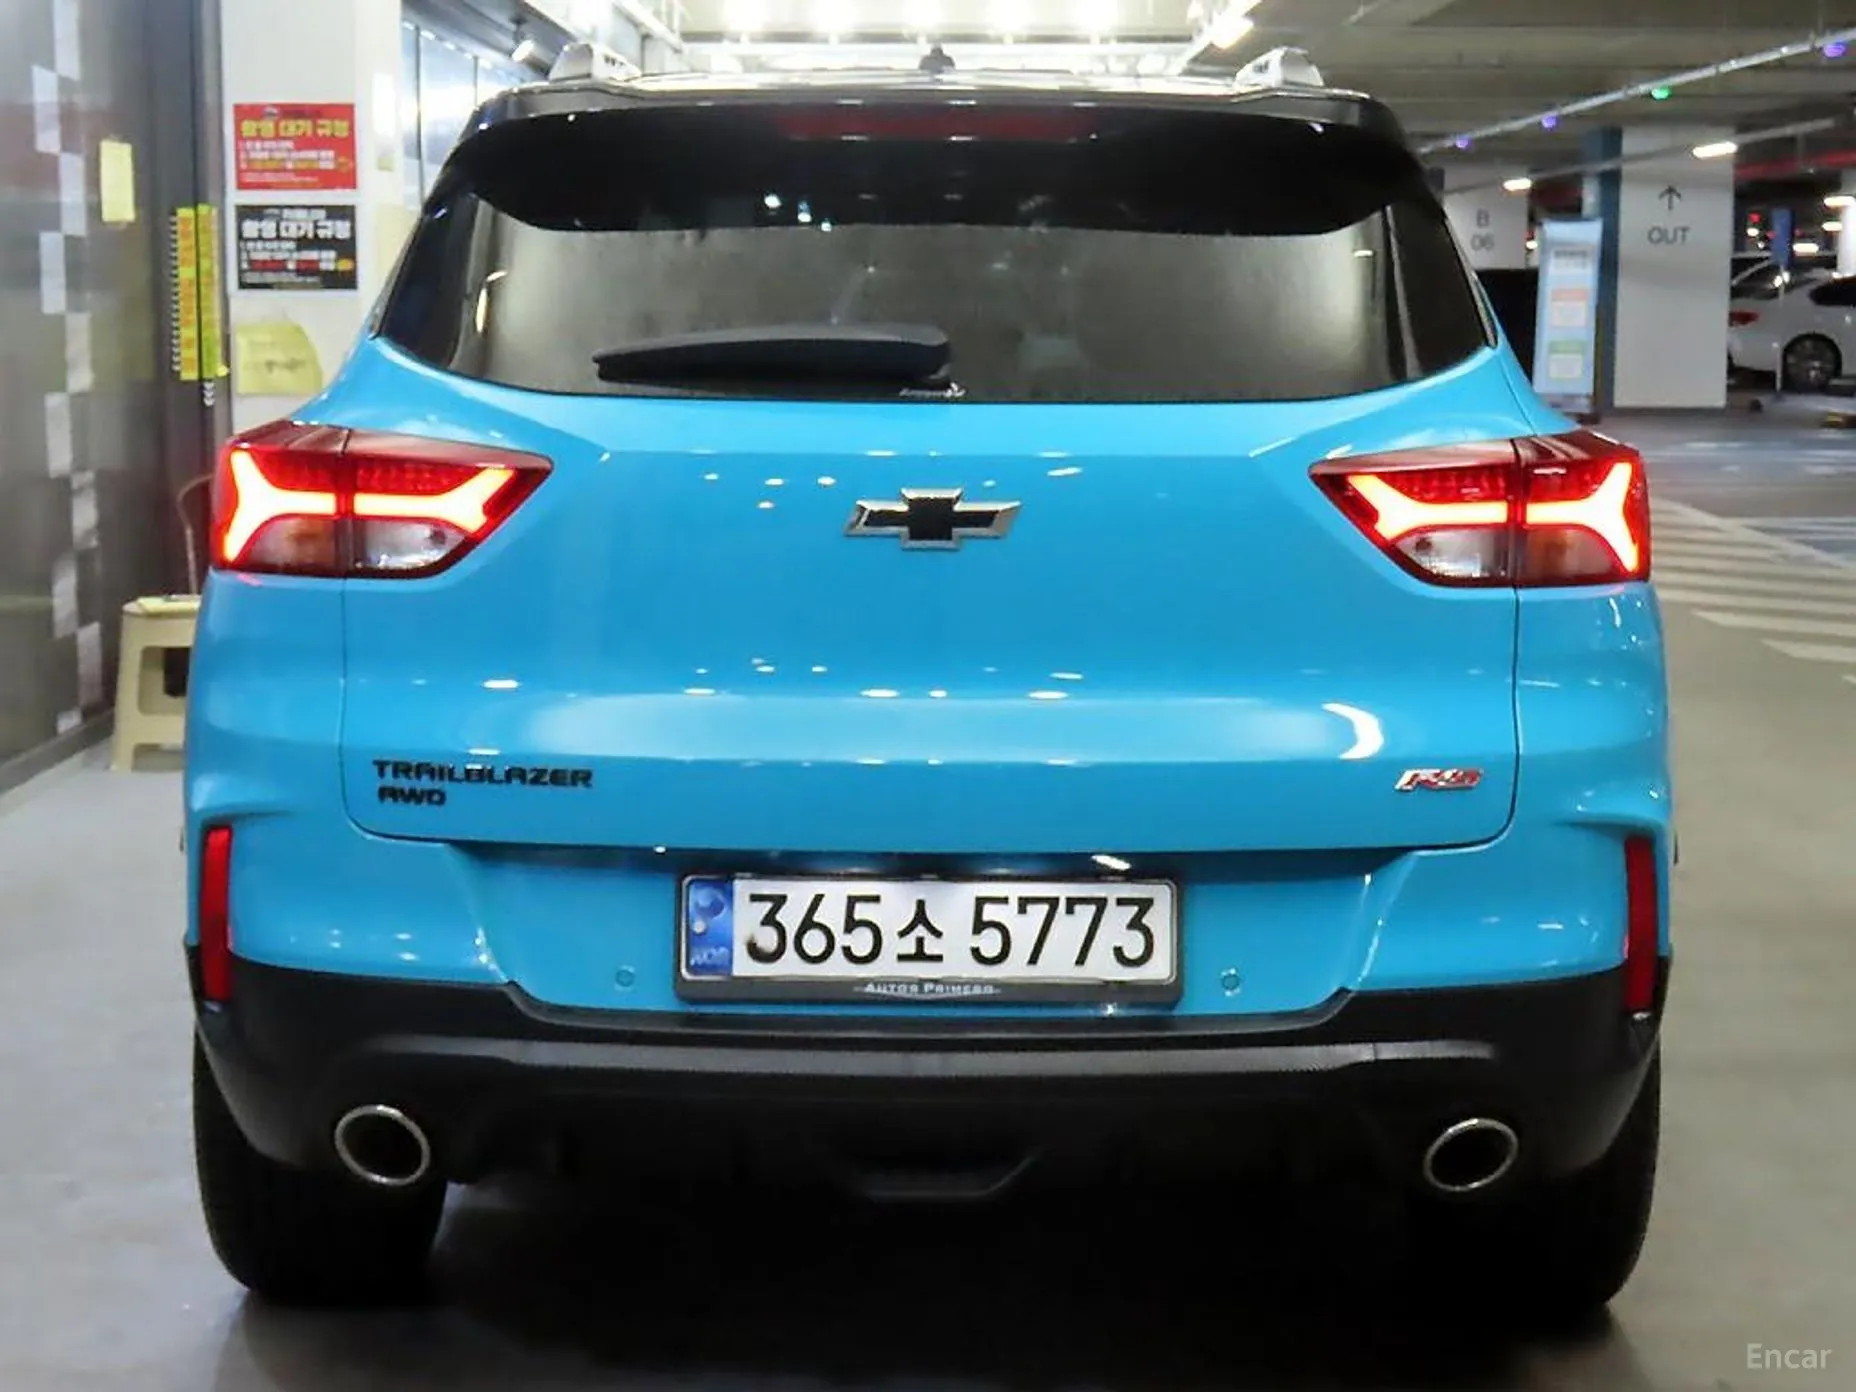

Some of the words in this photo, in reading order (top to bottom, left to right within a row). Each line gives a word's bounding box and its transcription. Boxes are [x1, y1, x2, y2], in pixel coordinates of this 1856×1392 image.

[1647, 226, 1691, 245] OUT
[373, 760, 593, 788] TRAILBLAZER
[378, 785, 447, 806] AWD
[746, 893, 944, 965] 365소
[970, 896, 1155, 967] 5773
